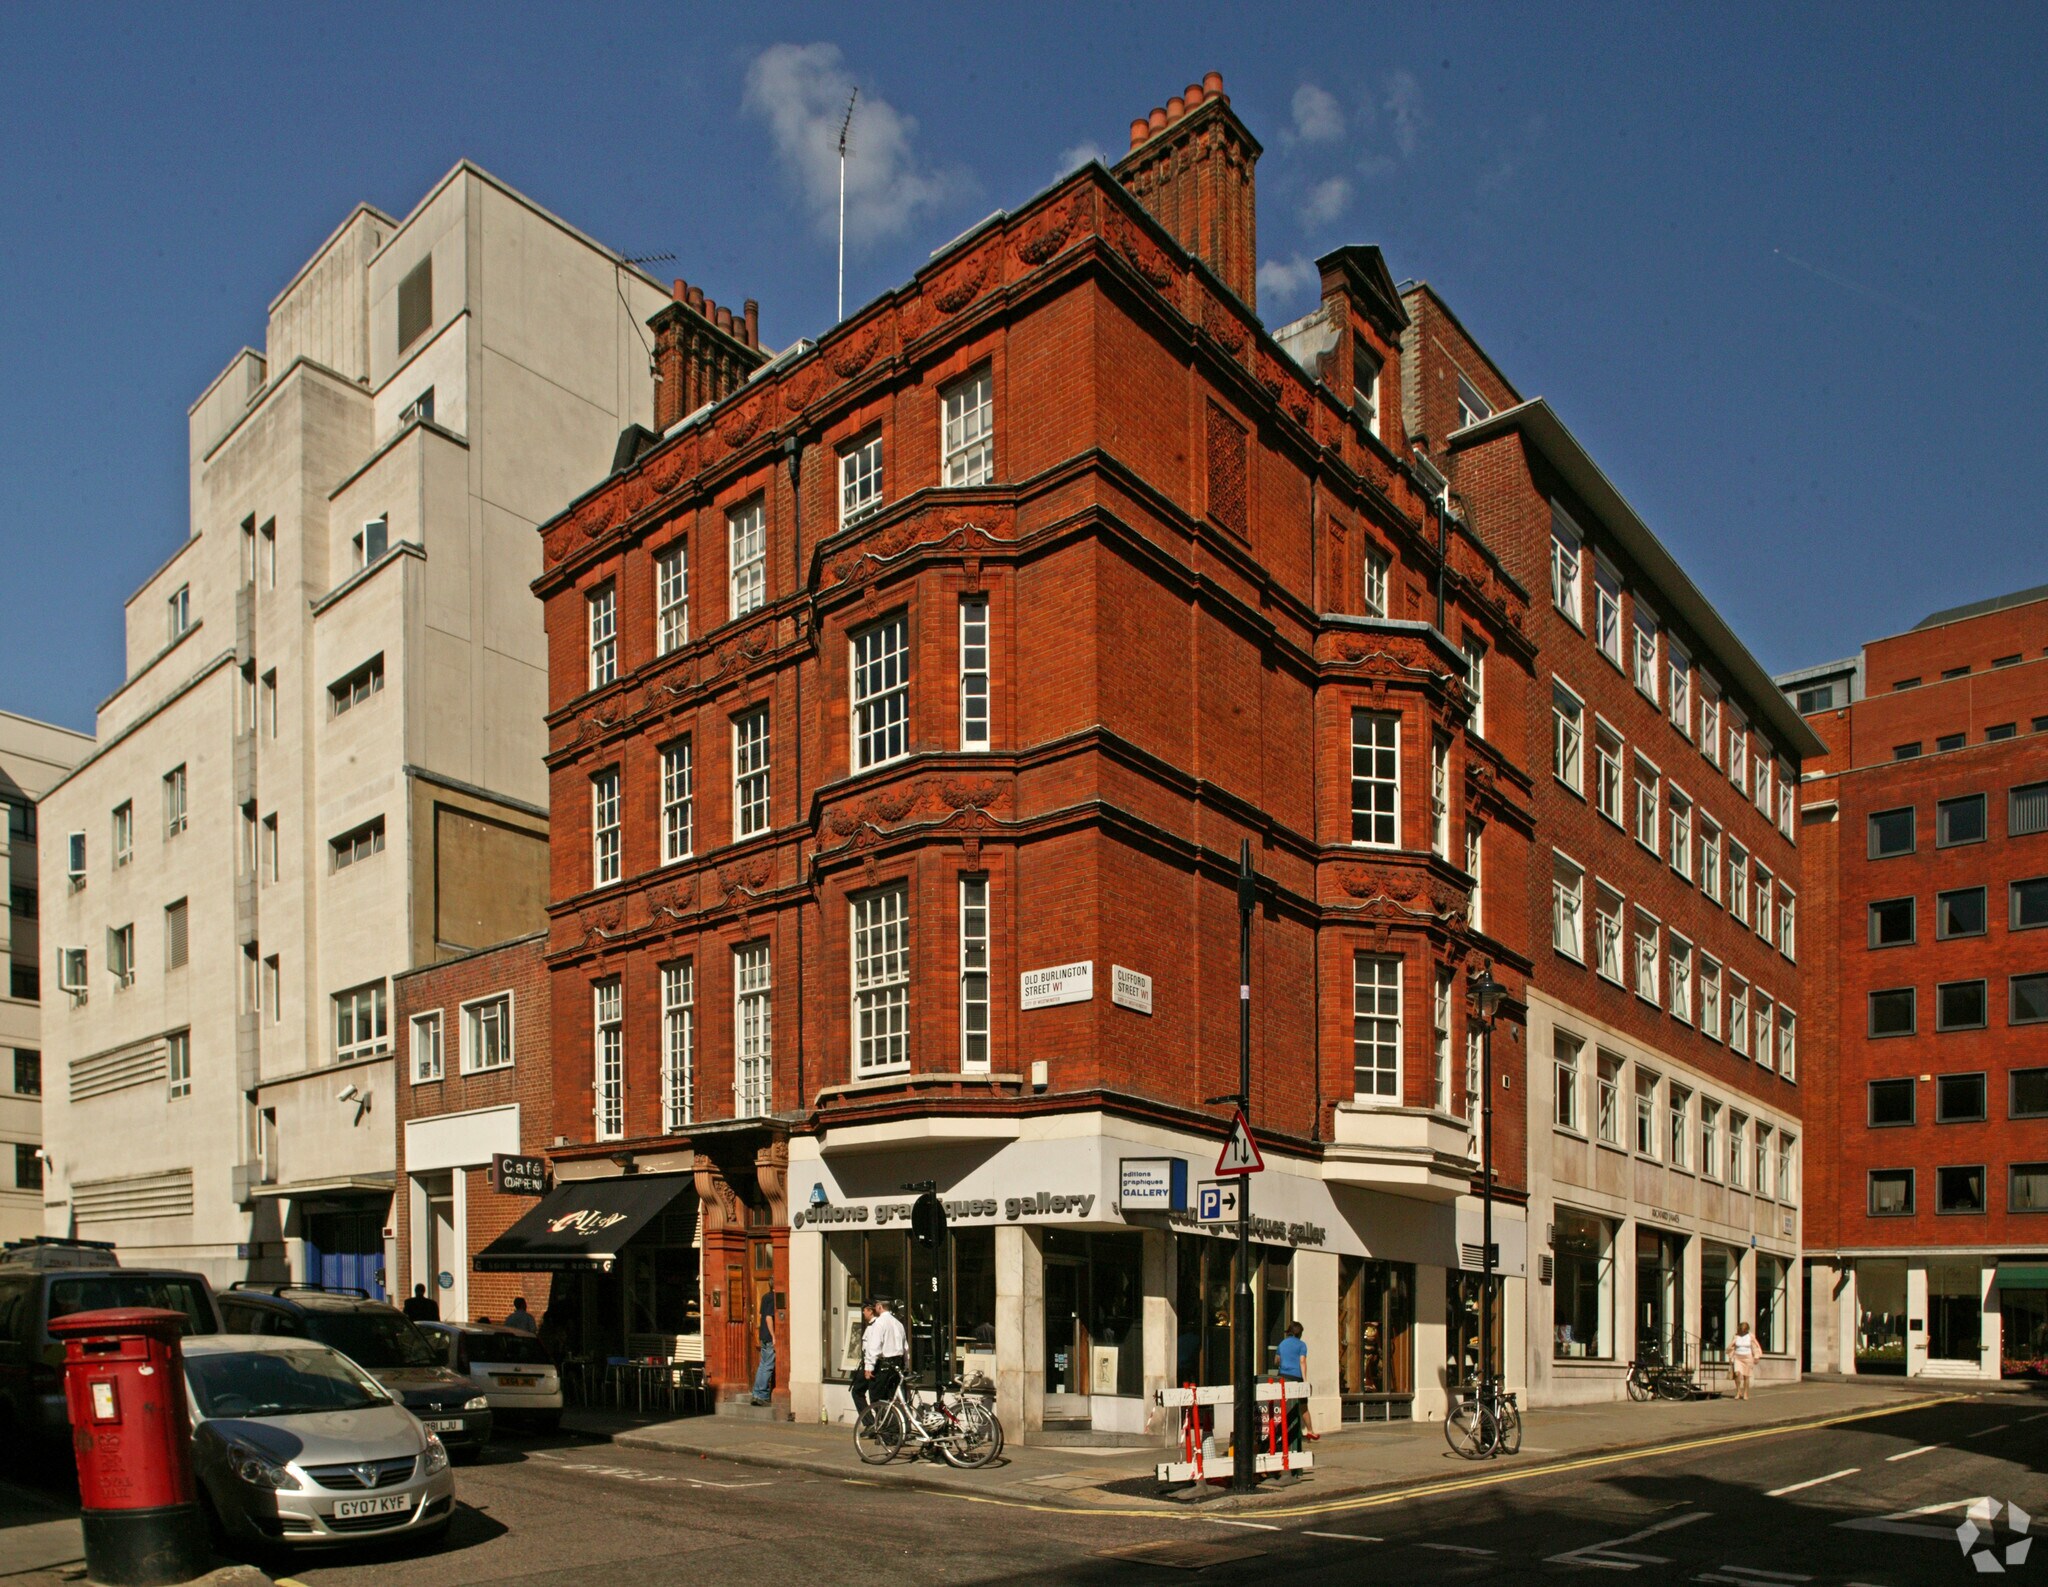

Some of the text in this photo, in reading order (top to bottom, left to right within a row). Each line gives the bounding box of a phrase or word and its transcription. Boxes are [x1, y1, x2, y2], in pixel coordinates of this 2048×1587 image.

[1025, 966, 1087, 985] OLD BURLINGTON
[1117, 970, 1146, 988] CLIFFORD
[1025, 982, 1063, 997] STREET W1
[1117, 982, 1149, 1000] STREET W1
[502, 1159, 541, 1176] Café
[1123, 1179, 1163, 1187] graphiques
[875, 1198, 998, 1225] graques
[1005, 1192, 1095, 1220] gallery
[1204, 1193, 1217, 1217] P
[440, 1421, 457, 1430] LJU
[341, 1496, 404, 1515] GY07 KYF
